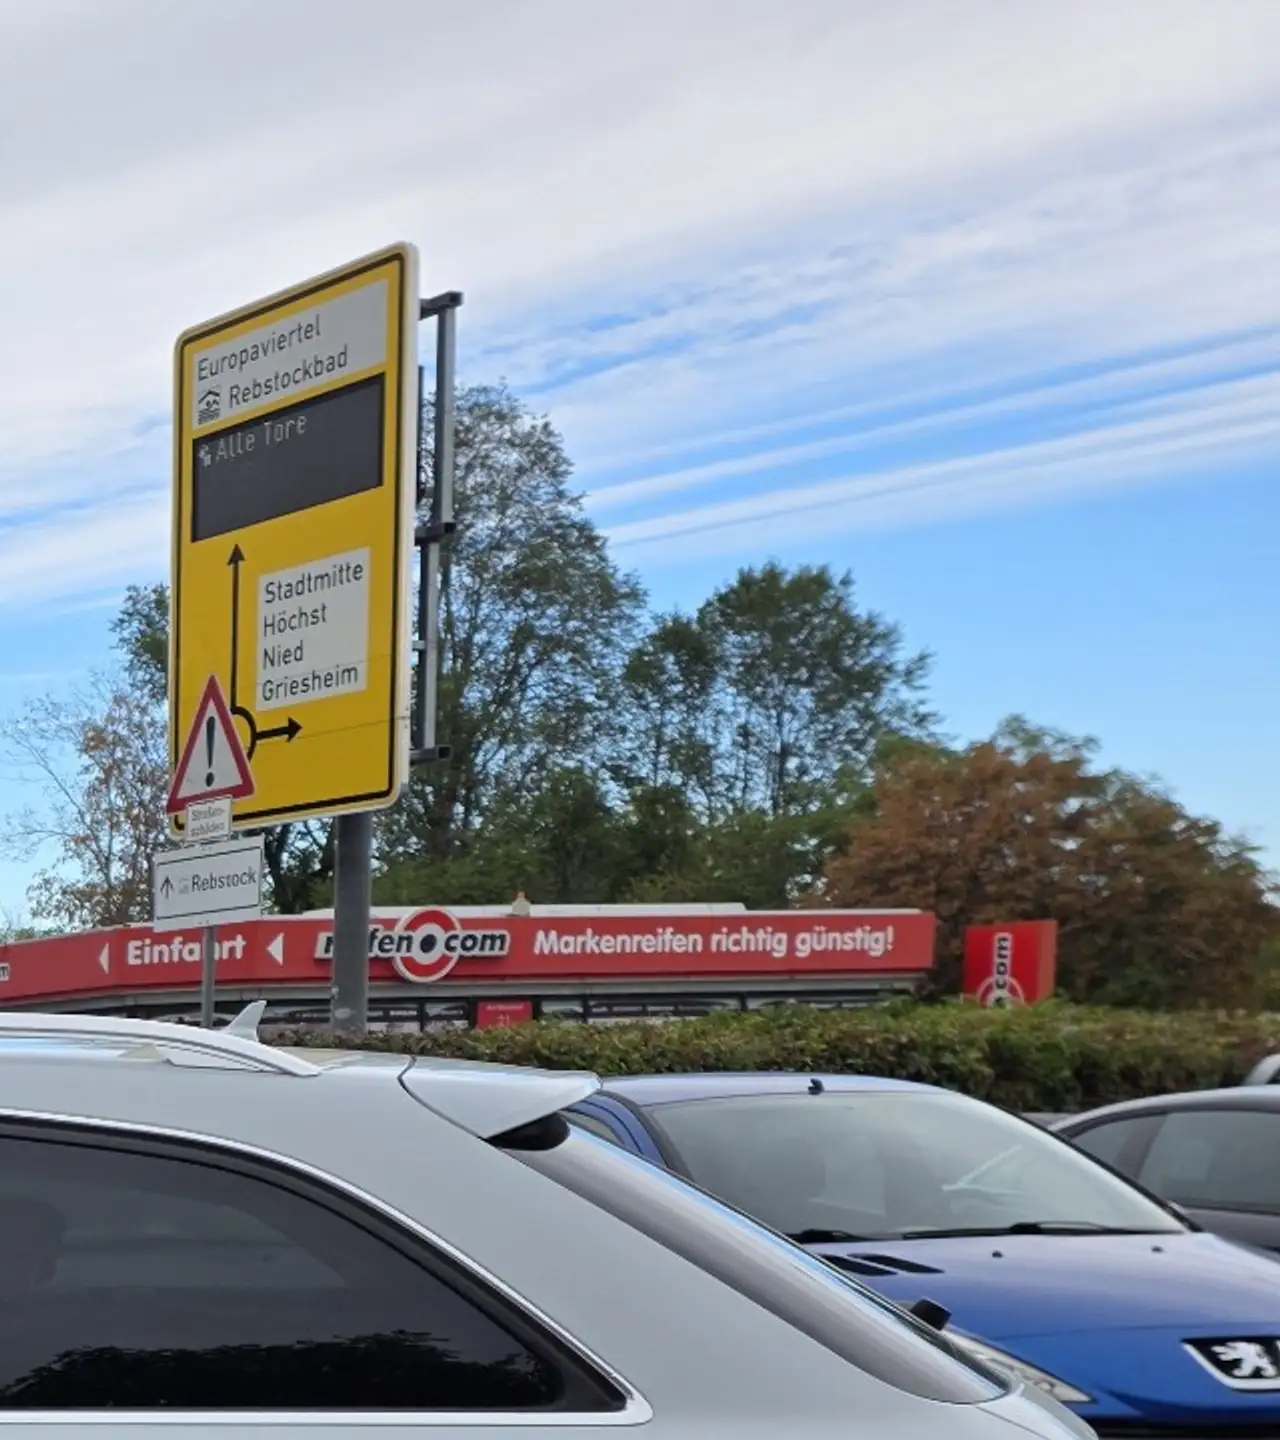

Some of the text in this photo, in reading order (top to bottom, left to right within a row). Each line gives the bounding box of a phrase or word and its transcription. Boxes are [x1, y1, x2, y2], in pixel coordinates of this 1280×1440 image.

[198, 314, 321, 381] Europaviertel
[229, 344, 348, 408] Rebstockbad
[215, 415, 308, 462] Alle Tore
[265, 563, 364, 604] Stadtmitte
[263, 602, 327, 637] Höchst
[263, 639, 304, 670] Nied
[262, 664, 359, 701] Griesheim
[191, 865, 256, 893] Rebstock
[534, 925, 894, 958] Markenreifen richtig günstig!
